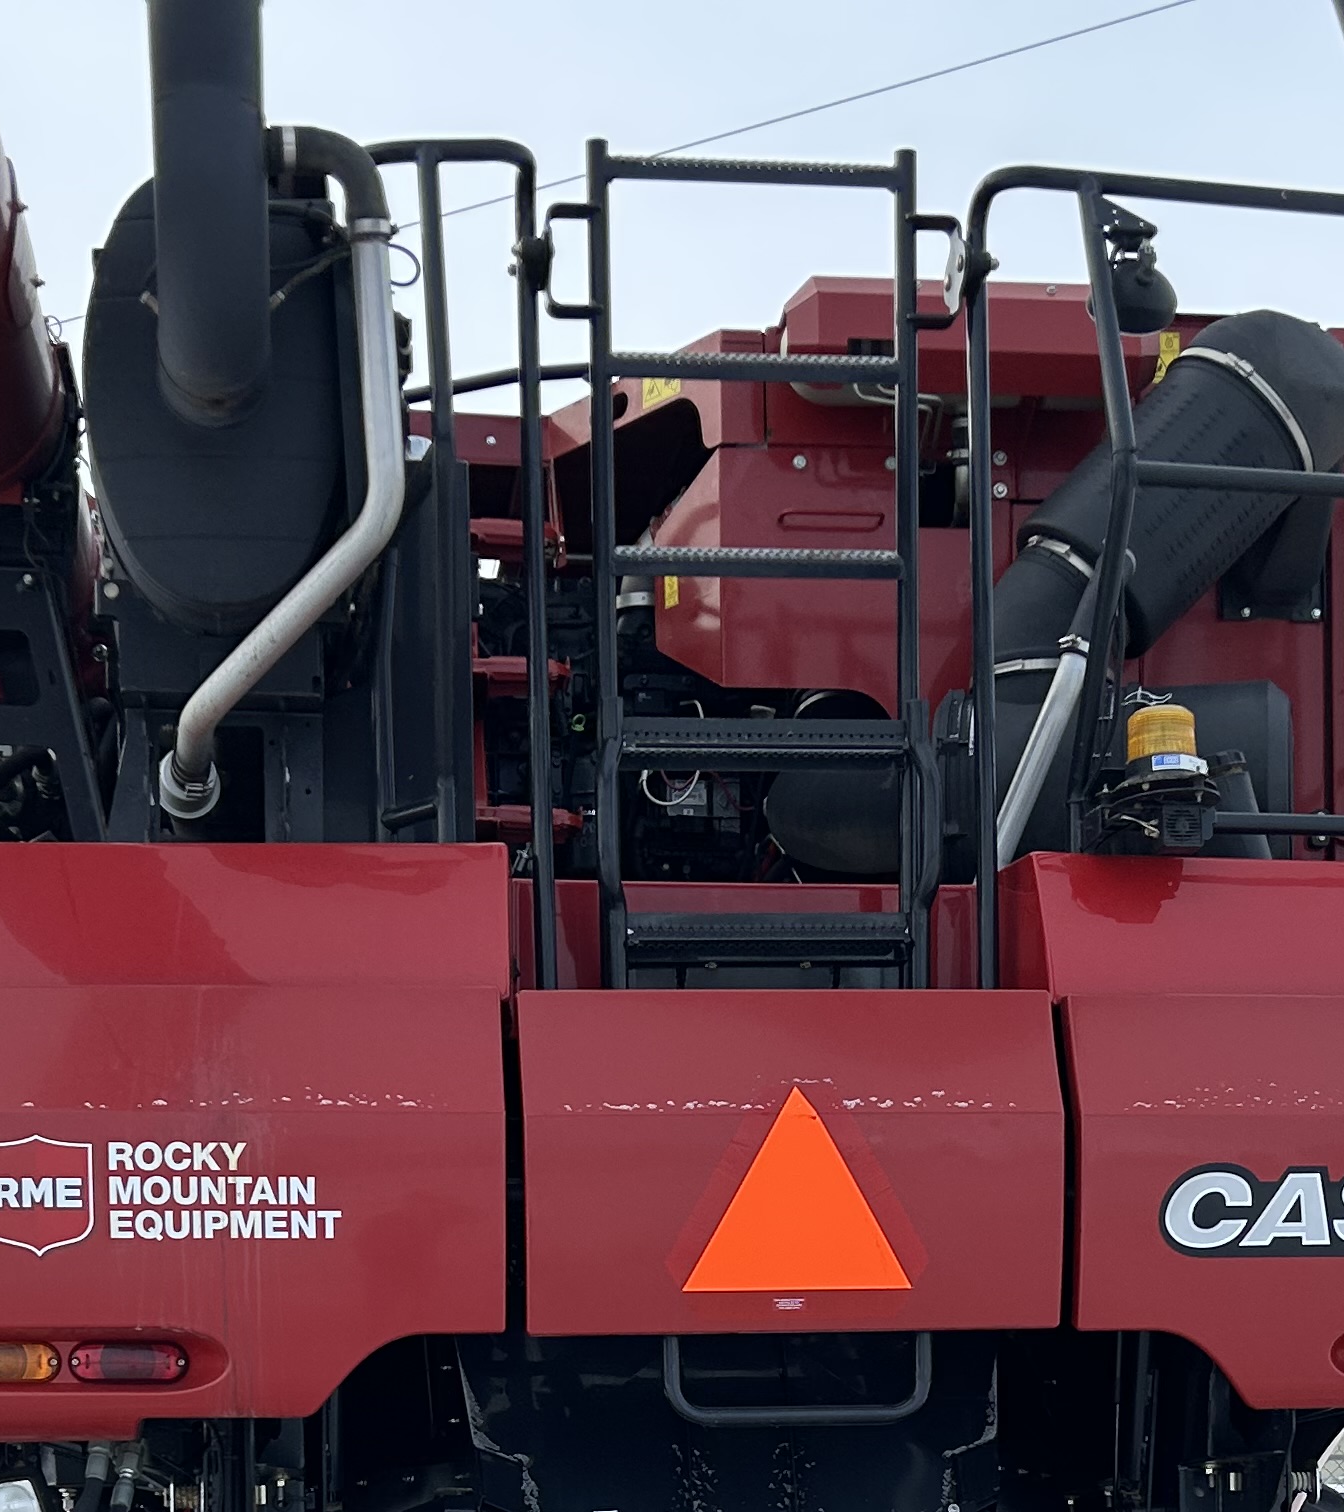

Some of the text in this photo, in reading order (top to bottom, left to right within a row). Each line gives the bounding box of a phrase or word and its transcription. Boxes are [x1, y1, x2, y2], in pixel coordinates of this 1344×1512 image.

[108, 1142, 246, 1170] ROCKY
[109, 1176, 315, 1205] MOUNTAIN
[110, 1210, 341, 1240] EQUIPMENT
